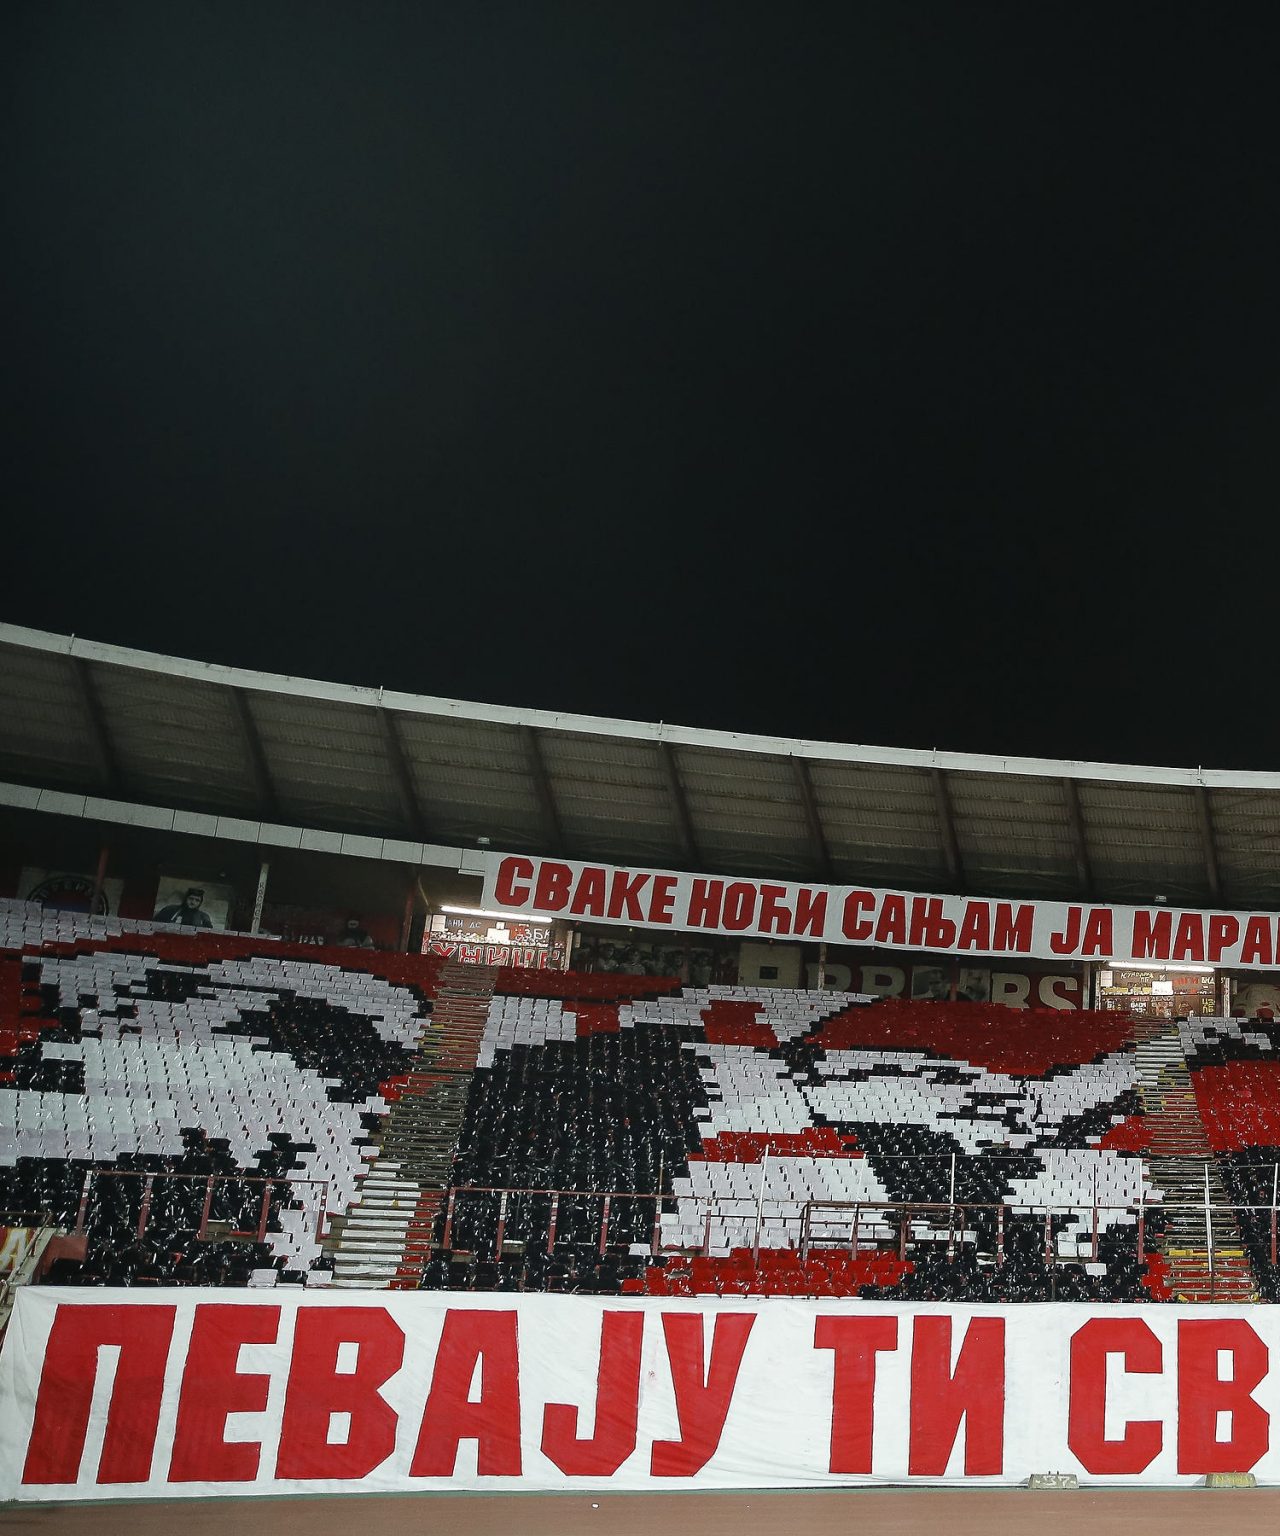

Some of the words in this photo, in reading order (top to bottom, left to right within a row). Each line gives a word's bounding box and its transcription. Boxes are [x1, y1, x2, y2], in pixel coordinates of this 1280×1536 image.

[494, 856, 678, 924] СВАКЕ
[686, 876, 829, 937] НОЋИ
[841, 890, 1036, 953] САЊАМ
[1049, 906, 1114, 957] ЈА
[22, 1303, 758, 1485] ПЕВАЈУ
[814, 1315, 1006, 1477] ТИ
